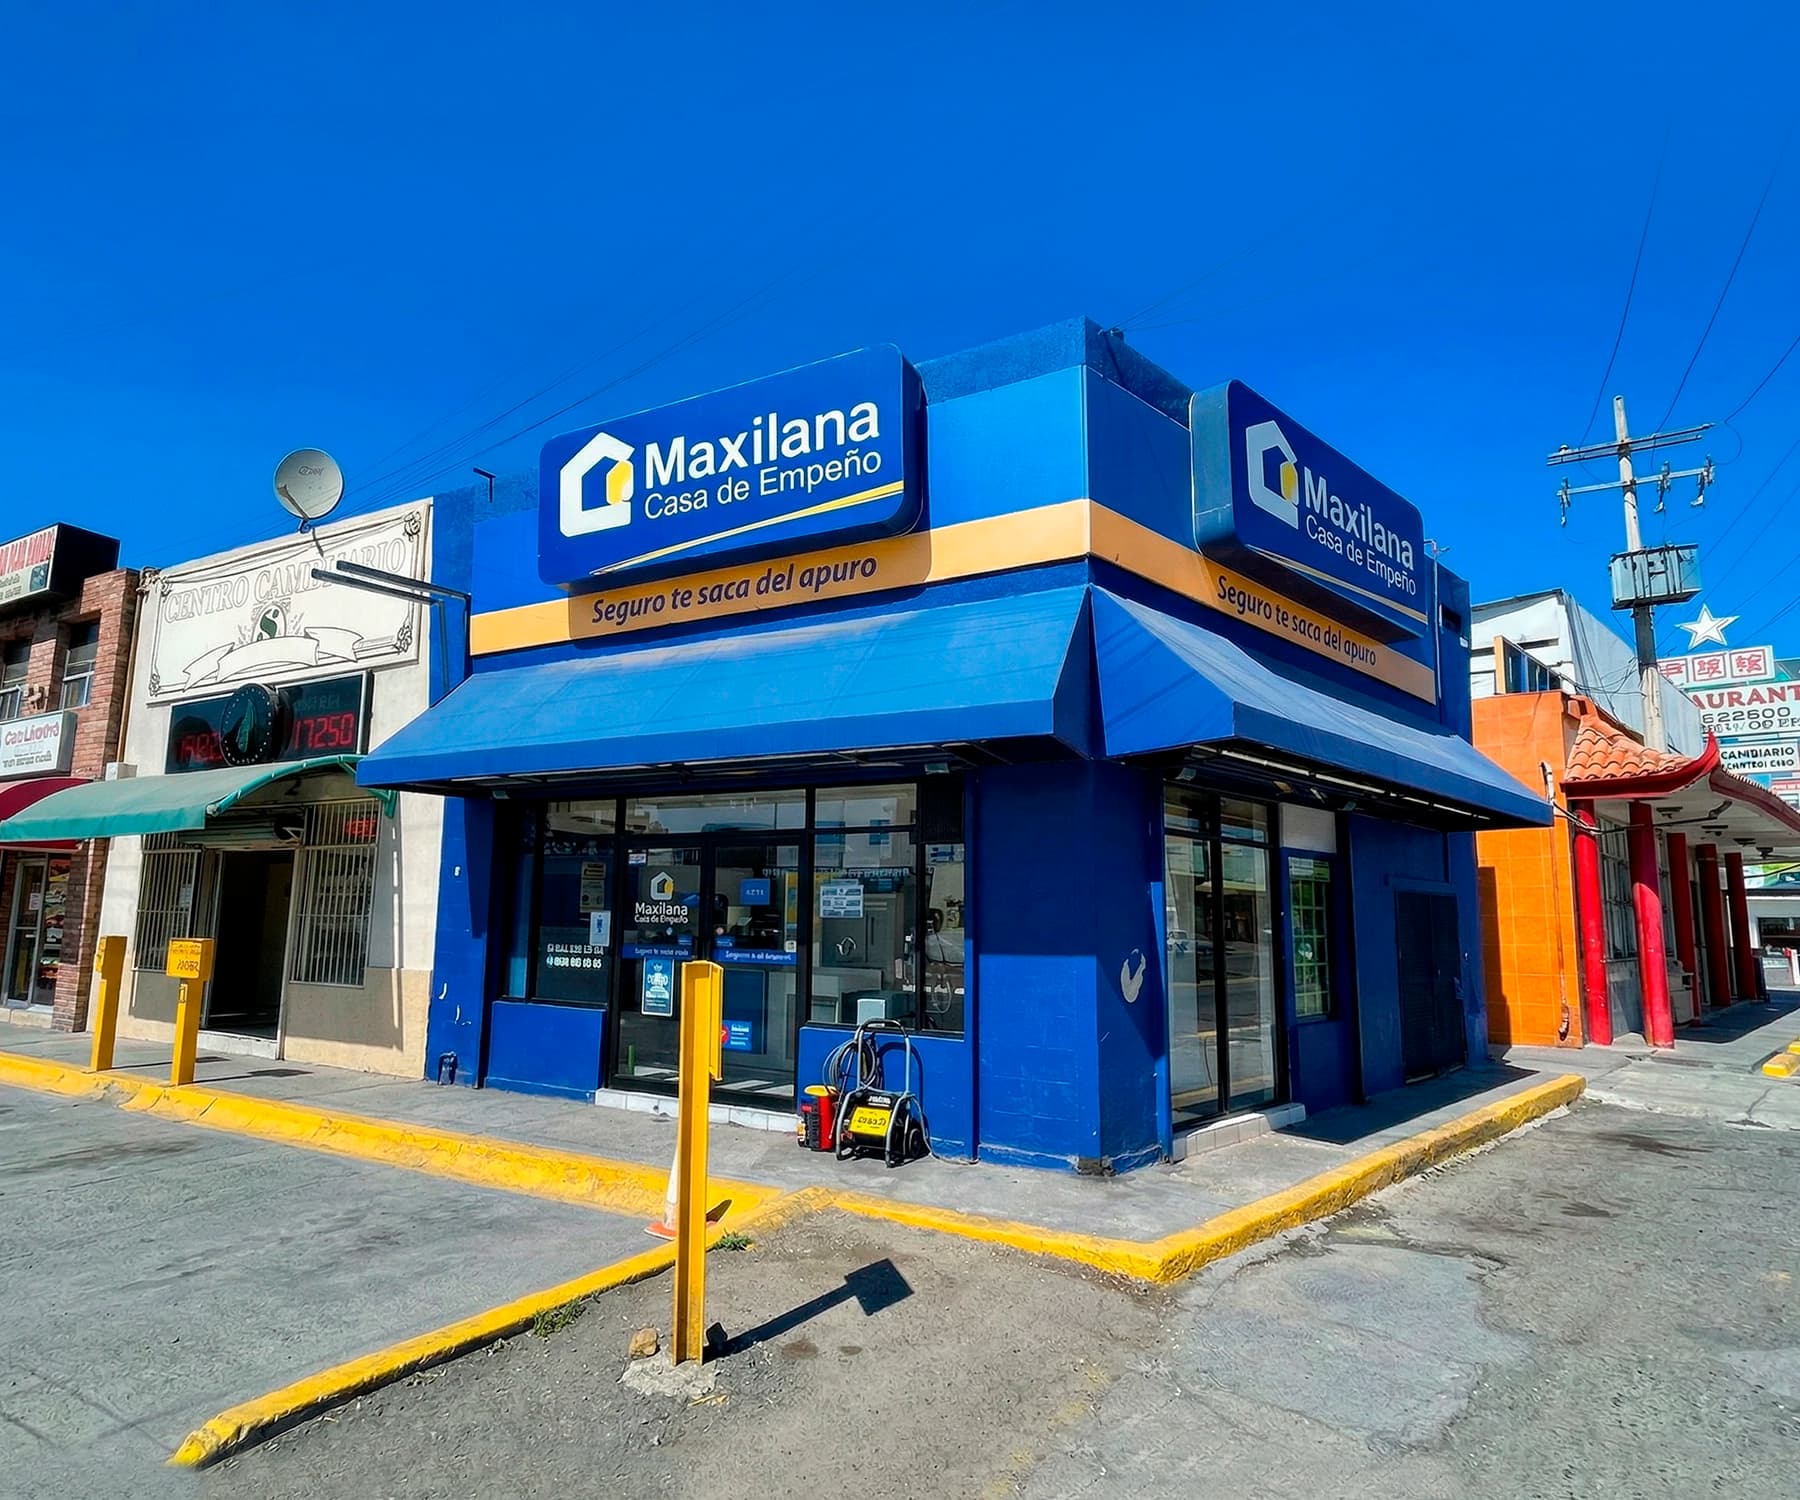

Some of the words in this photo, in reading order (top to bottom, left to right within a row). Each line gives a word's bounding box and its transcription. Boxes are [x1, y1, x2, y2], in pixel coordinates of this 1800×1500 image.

[644, 401, 880, 490] Maxilana
[644, 487, 708, 519] Casa
[717, 476, 750, 504] de
[759, 448, 882, 496] Empeño
[1303, 466, 1415, 571] Maxilana
[1305, 515, 1343, 554] Casa
[1346, 540, 1364, 566] de
[1366, 552, 1417, 596] Empeño
[164, 576, 250, 624] CENTRO
[592, 594, 666, 626] Seguro
[671, 586, 691, 609] te
[697, 577, 750, 605] saca
[756, 564, 793, 593] del
[799, 557, 878, 591] apuro
[1217, 575, 1273, 620] Seguro
[1276, 606, 1289, 628] te
[1292, 616, 1321, 643] saca
[1323, 626, 1341, 651] del
[1344, 636, 1377, 666] apuro
[635, 902, 688, 915] Maxilana
